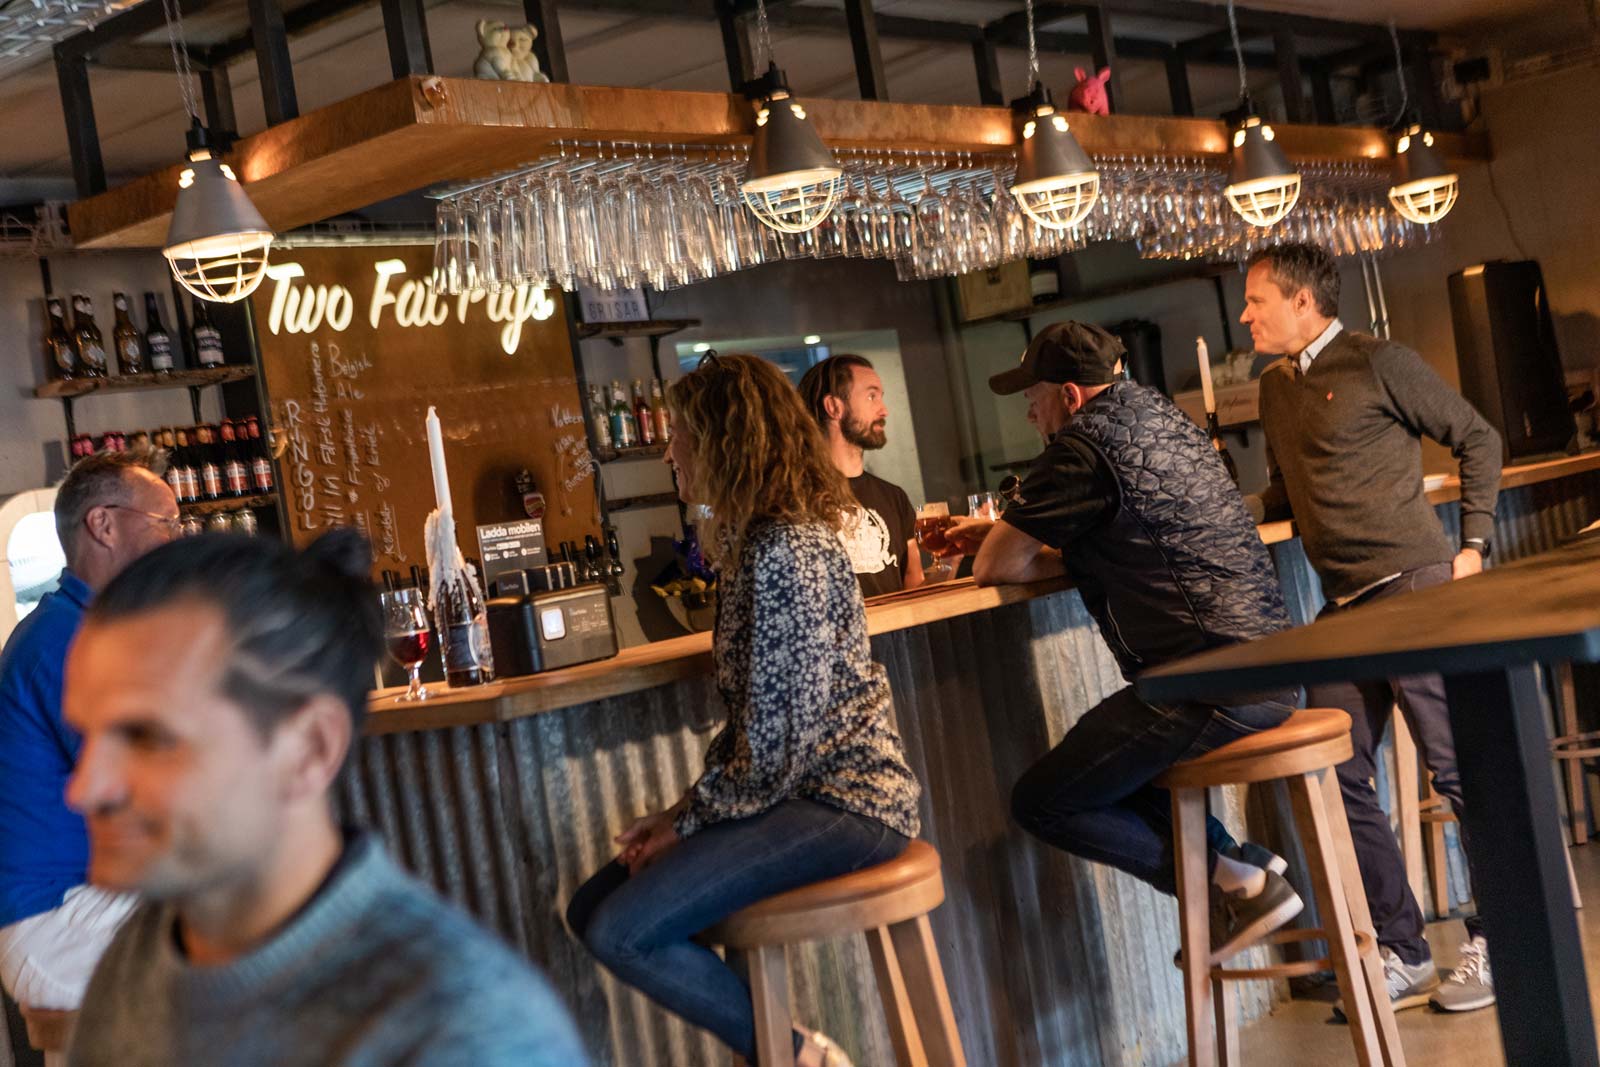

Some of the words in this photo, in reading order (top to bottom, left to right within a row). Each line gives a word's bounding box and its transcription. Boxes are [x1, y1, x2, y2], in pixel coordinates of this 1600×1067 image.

[267, 263, 354, 335] Two
[369, 259, 449, 329] Fat
[480, 525, 508, 539] Ladda
[508, 522, 541, 536] mobilen
